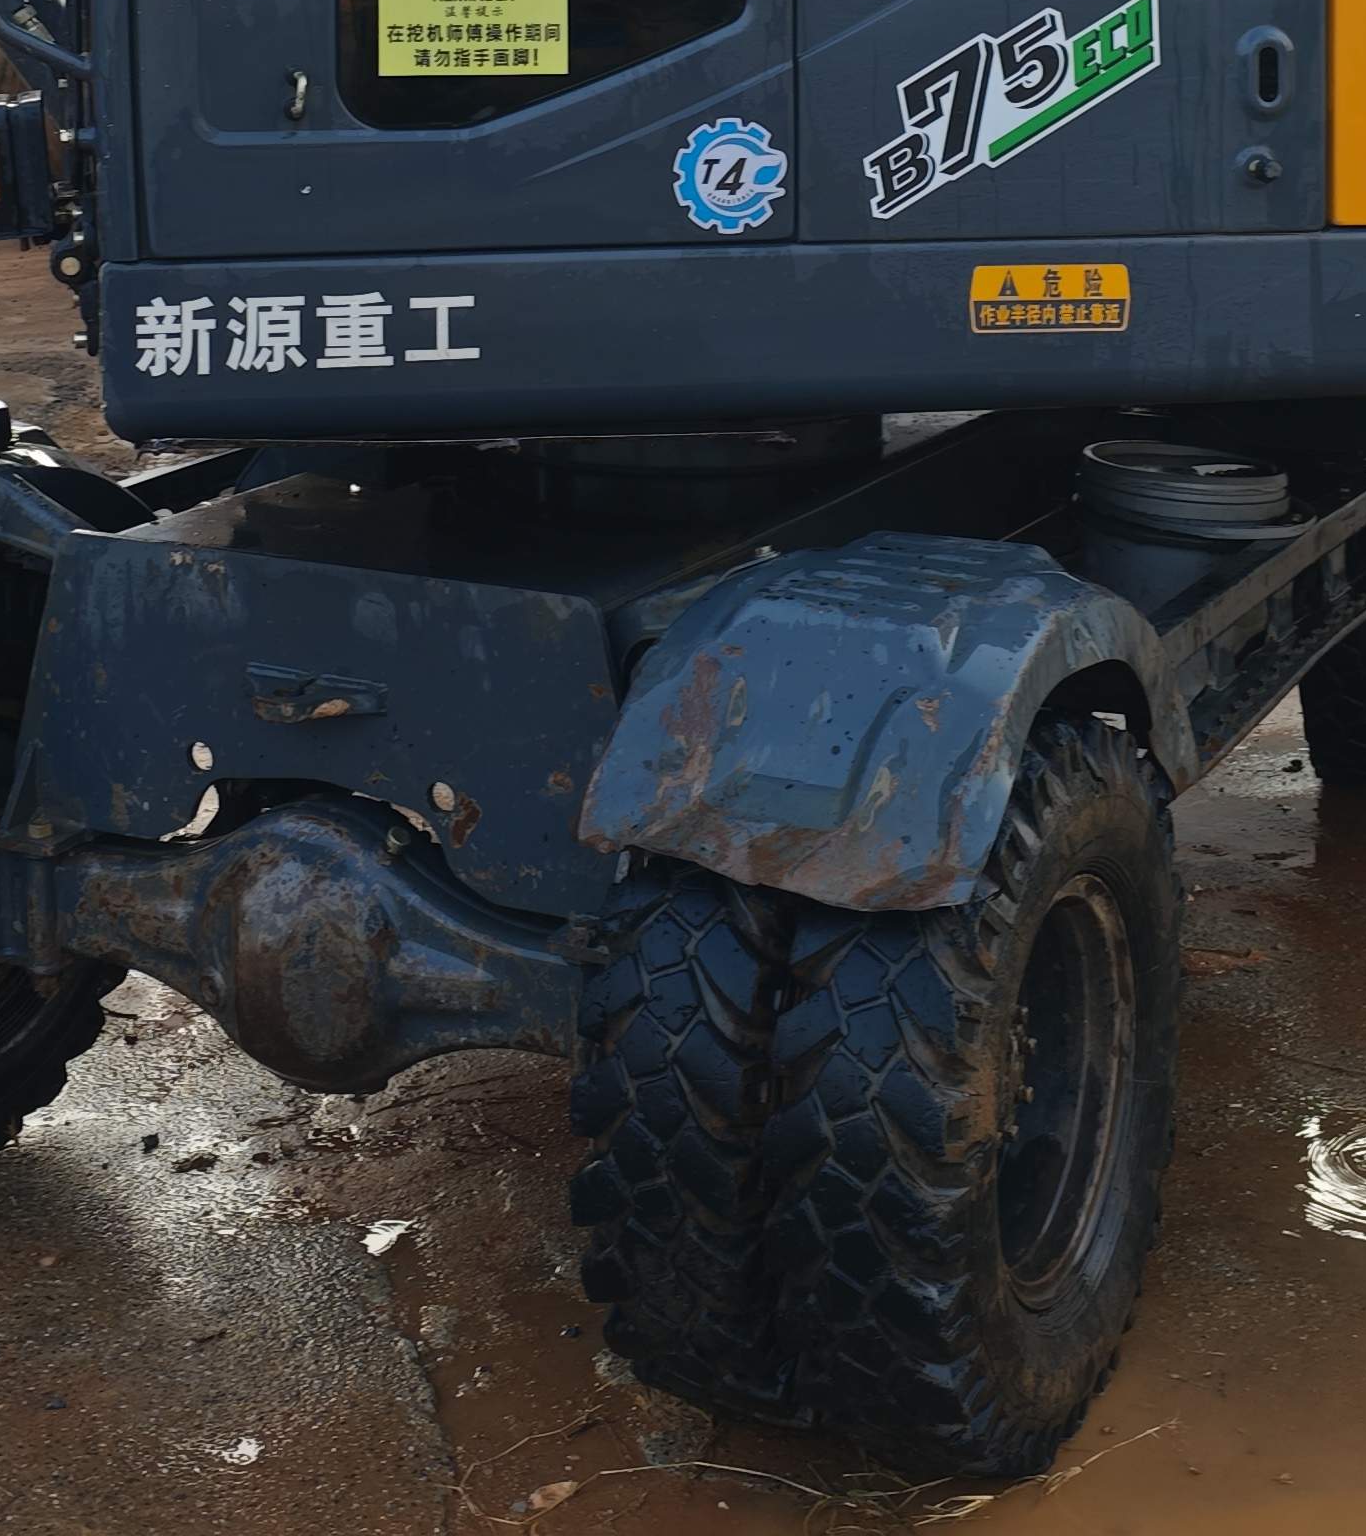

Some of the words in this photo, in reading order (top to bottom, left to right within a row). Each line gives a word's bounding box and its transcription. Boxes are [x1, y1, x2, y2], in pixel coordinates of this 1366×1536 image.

[386, 23, 561, 44] 在挖机师傅操作期间
[868, 13, 1069, 213] B75
[701, 157, 748, 196] T4
[135, 291, 481, 377] 新源重工
